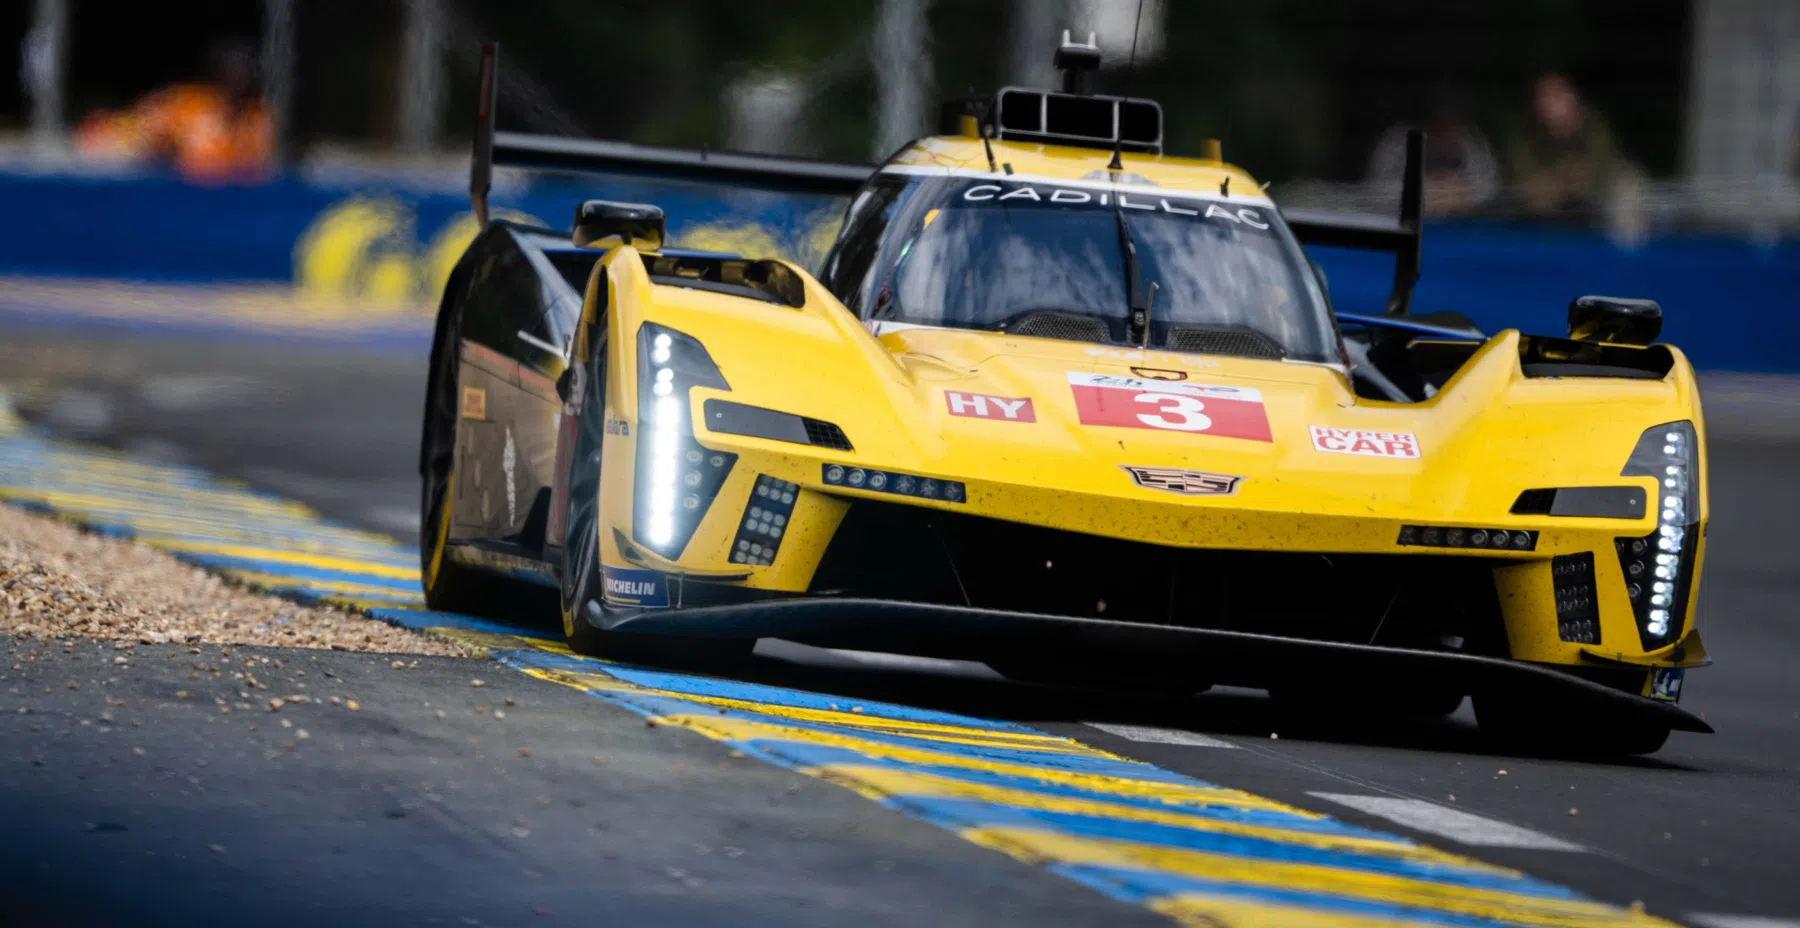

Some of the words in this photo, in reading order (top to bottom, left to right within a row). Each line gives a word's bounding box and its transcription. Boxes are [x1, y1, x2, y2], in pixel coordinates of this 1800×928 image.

[963, 185, 1270, 230] CADILLAC
[949, 392, 1027, 419] HY
[1133, 393, 1212, 431] 3
[1315, 428, 1412, 441] HYPER
[1317, 436, 1415, 456] CAR
